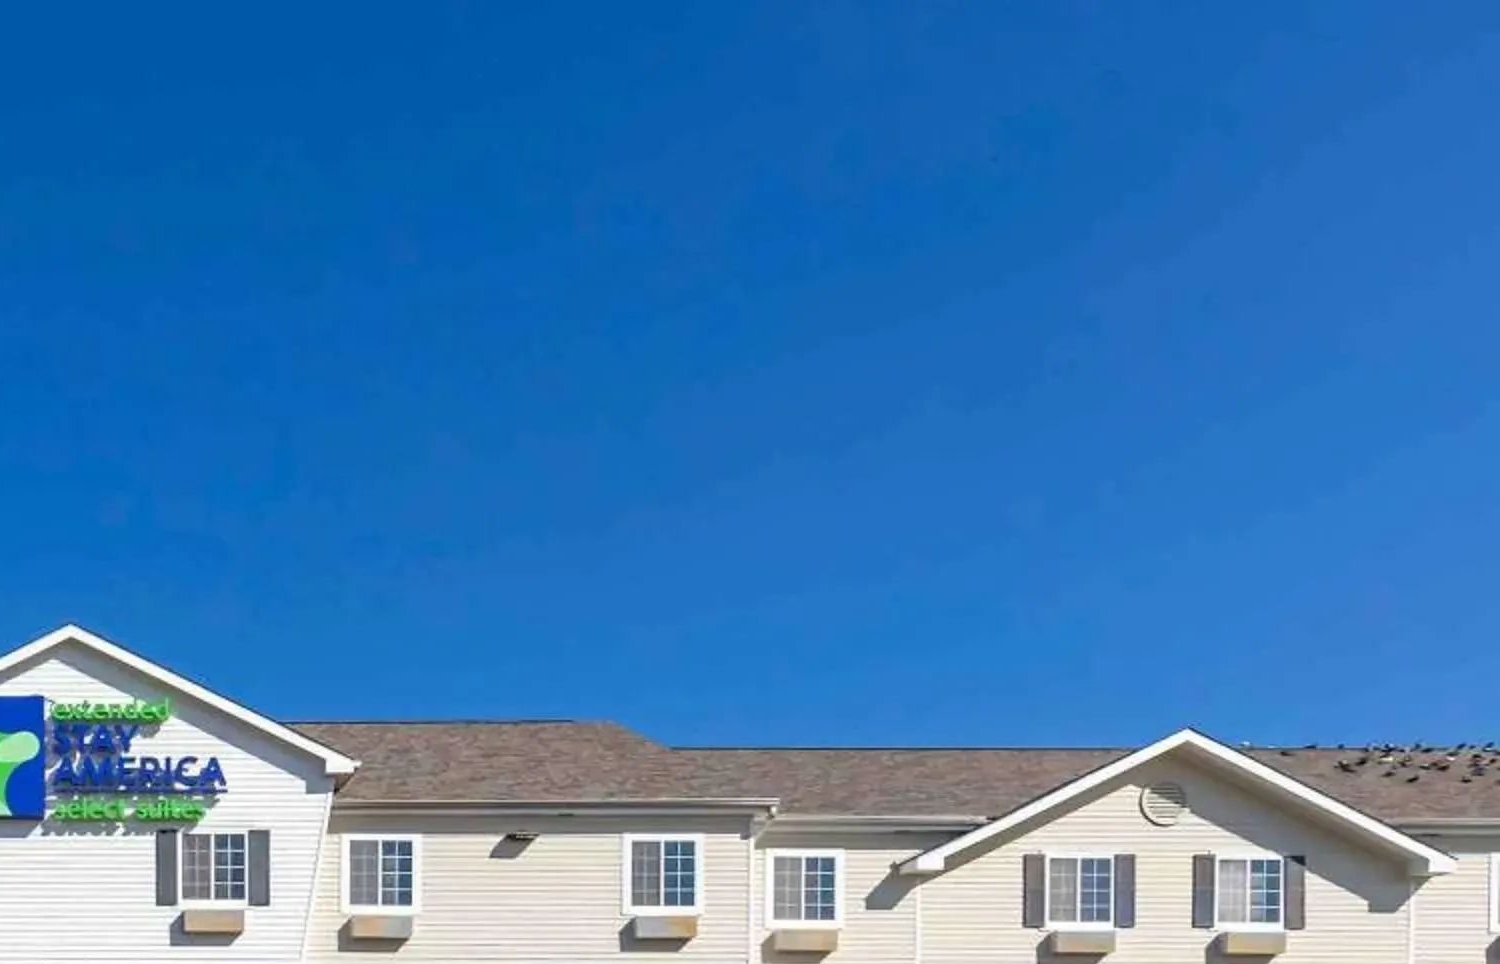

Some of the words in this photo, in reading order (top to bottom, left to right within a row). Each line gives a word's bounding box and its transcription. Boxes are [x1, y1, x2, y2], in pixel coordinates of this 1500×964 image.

[53, 697, 171, 721] extended
[53, 723, 139, 753] STAY
[53, 756, 228, 786] AMERICA
[54, 797, 127, 820] select
[136, 796, 206, 821] suites
